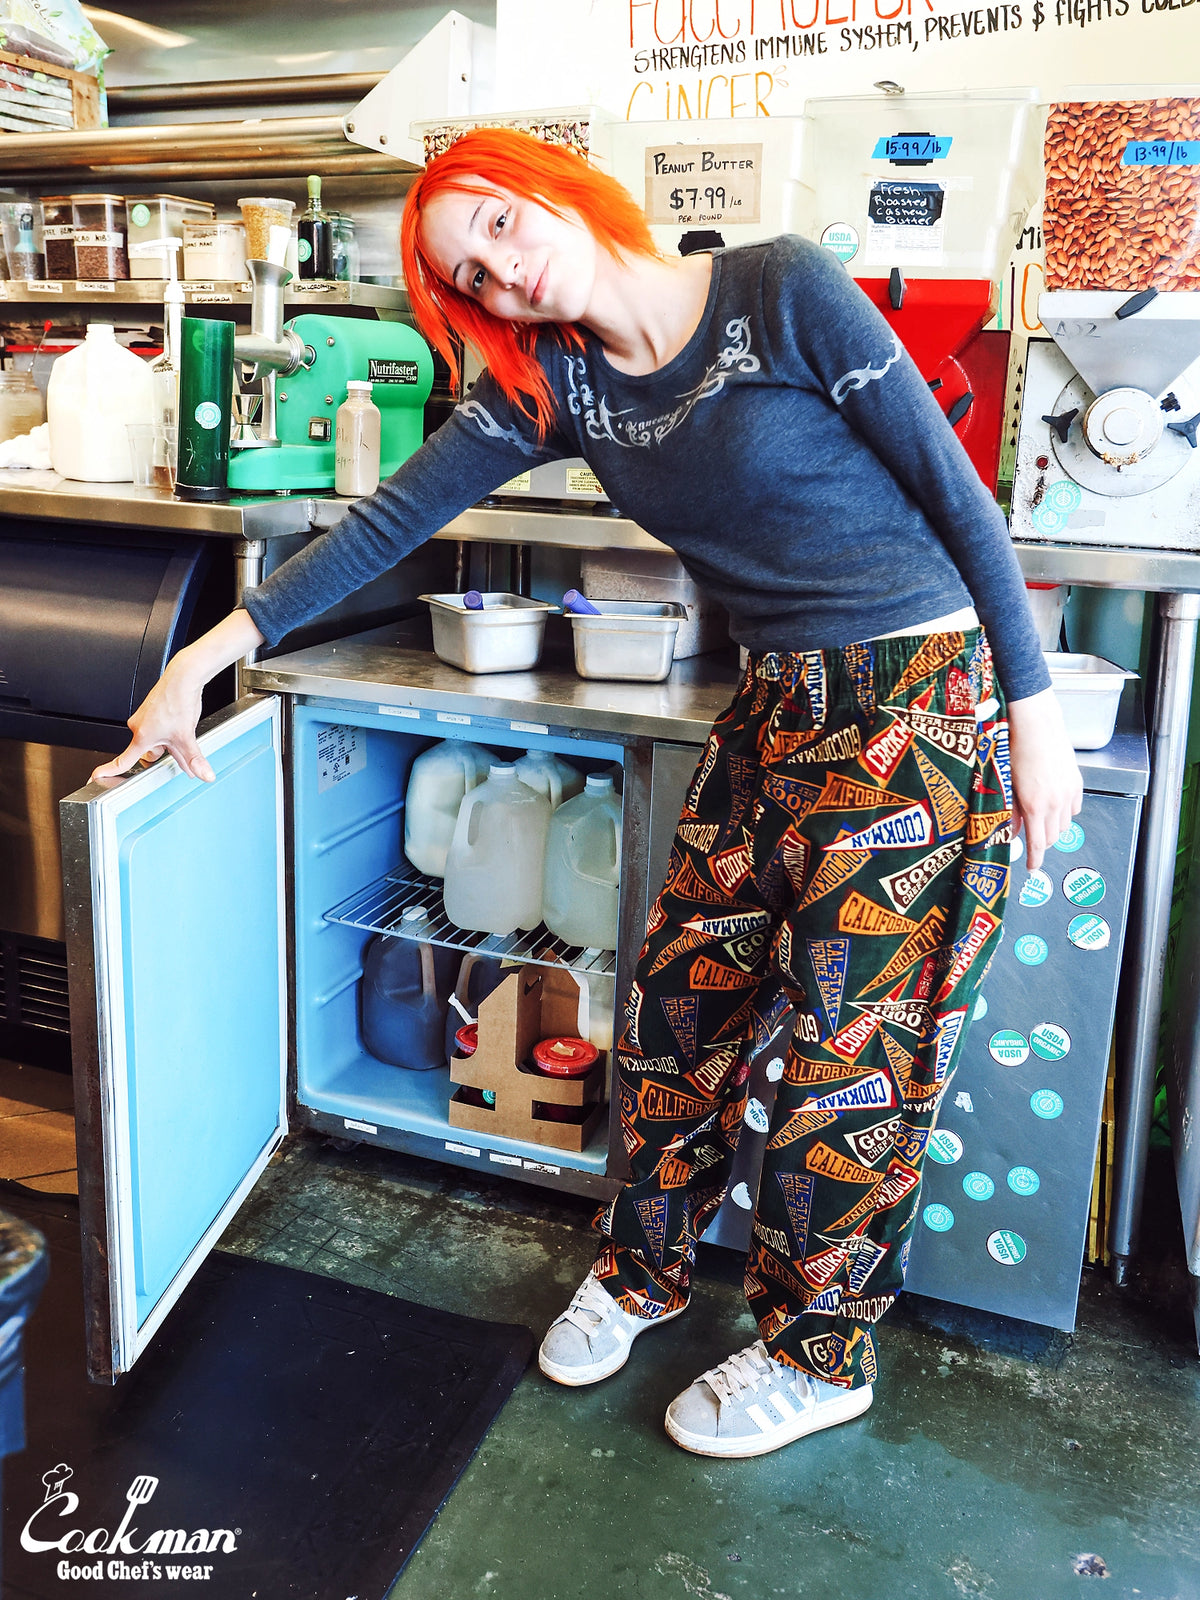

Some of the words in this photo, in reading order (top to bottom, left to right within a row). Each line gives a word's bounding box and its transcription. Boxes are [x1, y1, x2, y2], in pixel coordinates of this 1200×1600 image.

[755, 31, 828, 61] IMMUNE
[840, 20, 919, 52] SYSTEM,
[924, 4, 1023, 42] PREVENTS
[678, 215, 692, 223] PER
[828, 232, 852, 242] USDA
[370, 360, 415, 377] Nutrifaster
[911, 719, 974, 756] GOOD
[851, 811, 925, 848] COOKMAN
[894, 846, 954, 896] GOOD
[1027, 876, 1045, 891] SDA
[1068, 873, 1093, 892] USDA
[1075, 881, 1102, 903] ORGANIC
[1072, 918, 1098, 942] ORGANIC
[810, 940, 828, 981] VENICE
[826, 940, 845, 1013] CAL-STATE
[993, 1039, 1025, 1047] ORGANIC
[1032, 1037, 1062, 1058] ORGANIC
[1041, 1028, 1065, 1047] USDA
[997, 1049, 1022, 1058] USDA
[816, 1076, 887, 1109] COOKMAN
[928, 1136, 951, 1163] ORGANIC
[938, 1133, 958, 1155] USDA
[993, 1237, 1009, 1260] USDA
[1003, 1233, 1021, 1260] ORGANIC
